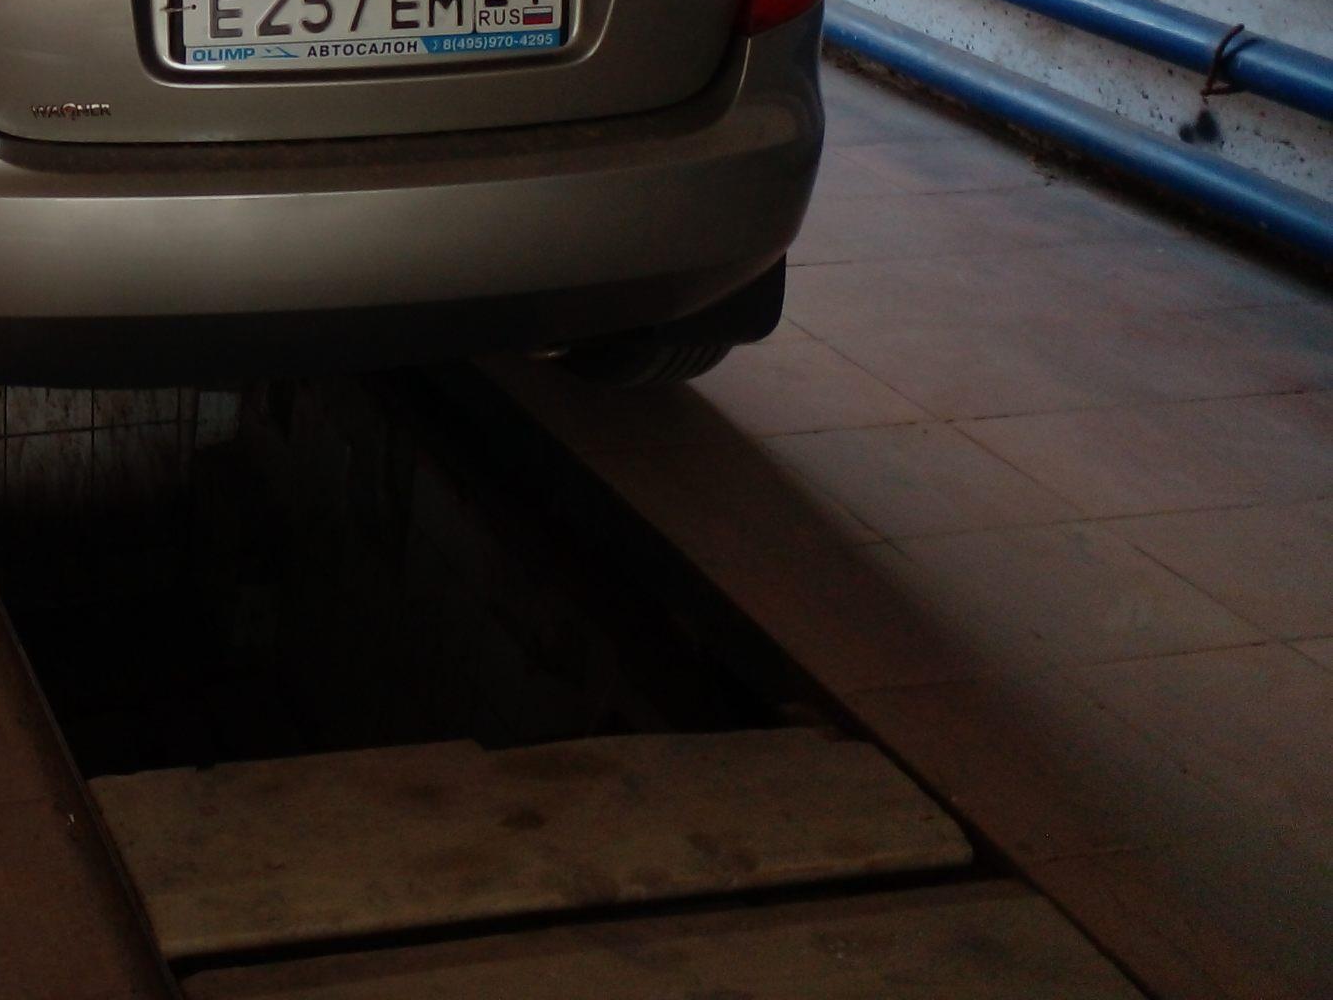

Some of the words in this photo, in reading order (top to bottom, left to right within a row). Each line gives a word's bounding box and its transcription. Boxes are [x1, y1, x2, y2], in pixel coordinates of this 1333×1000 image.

[478, 9, 520, 26] RUS
[192, 47, 255, 62] OLIMP
[307, 40, 417, 58] АВТОСАЛОН
